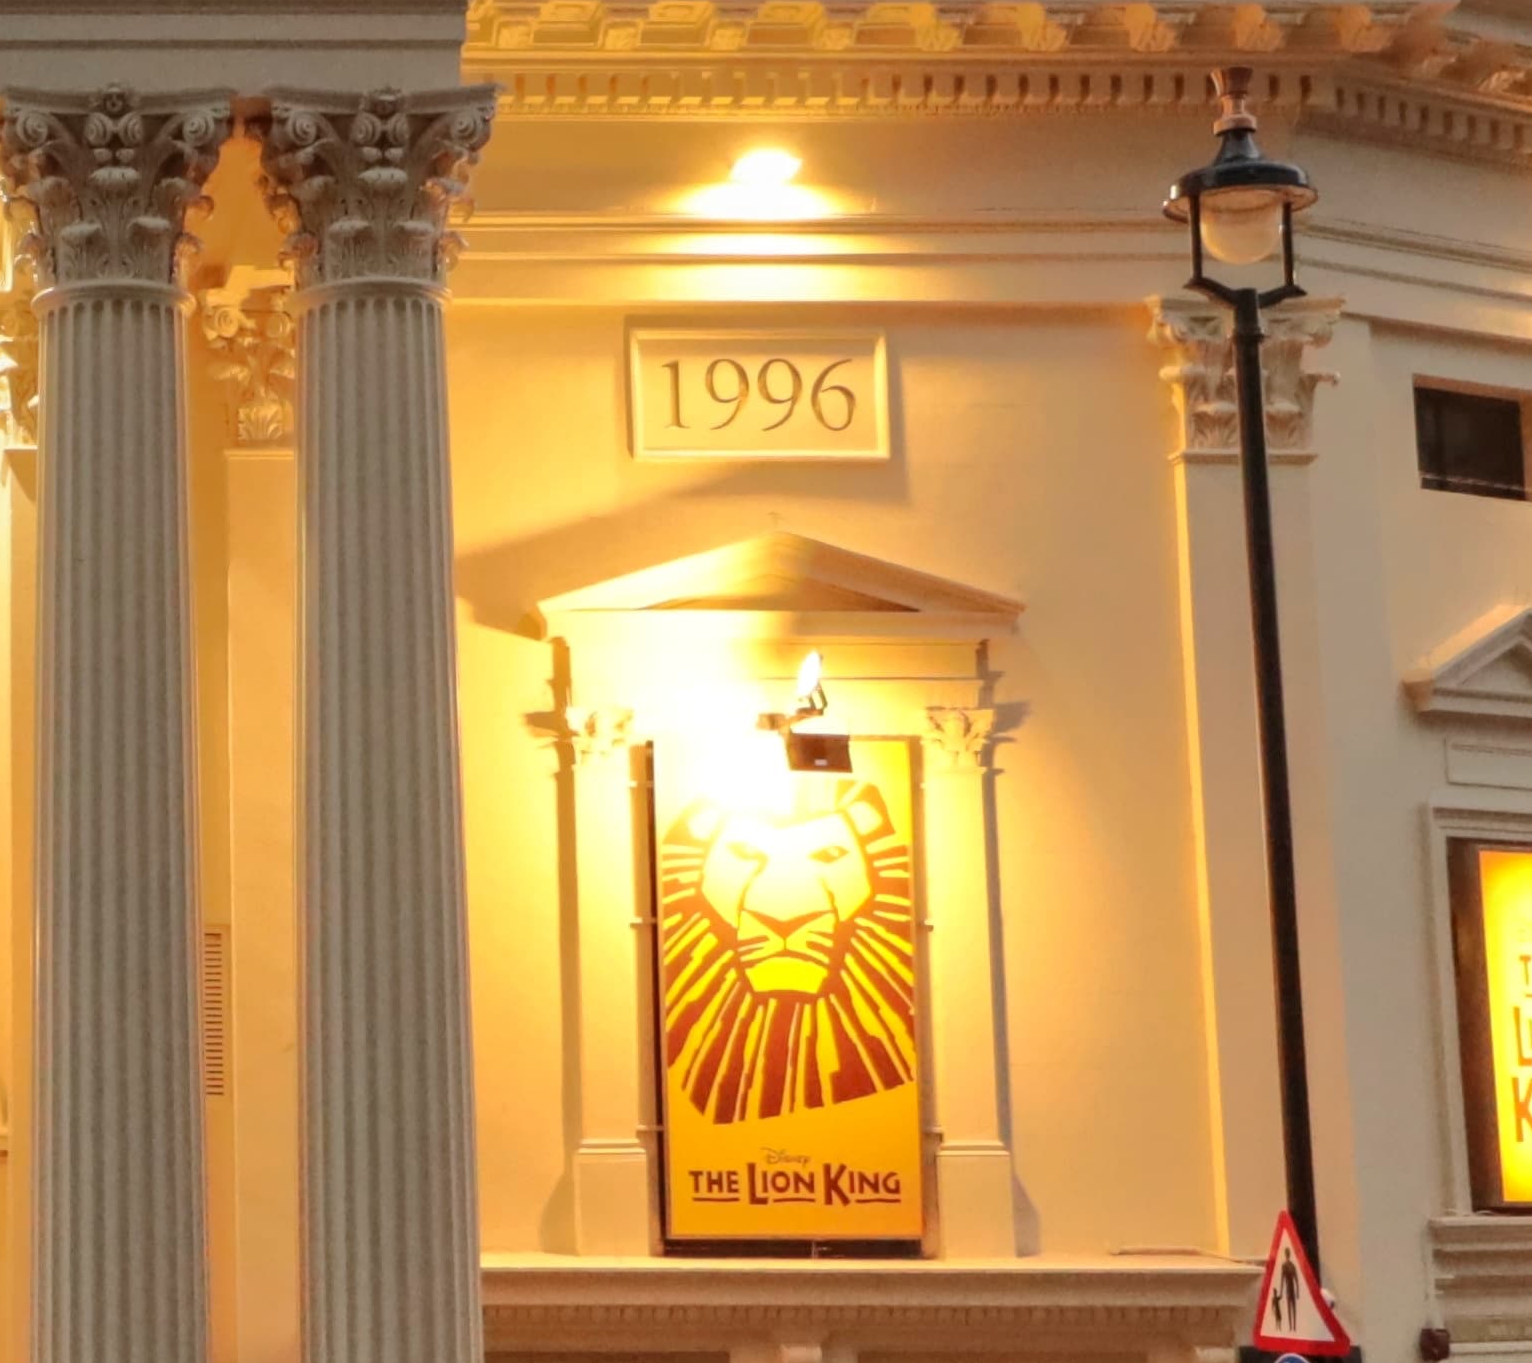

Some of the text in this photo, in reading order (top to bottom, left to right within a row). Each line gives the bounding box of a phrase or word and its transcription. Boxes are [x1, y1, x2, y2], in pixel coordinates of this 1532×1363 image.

[662, 358, 856, 432] 1996
[689, 1163, 901, 1206] THE LION KING
